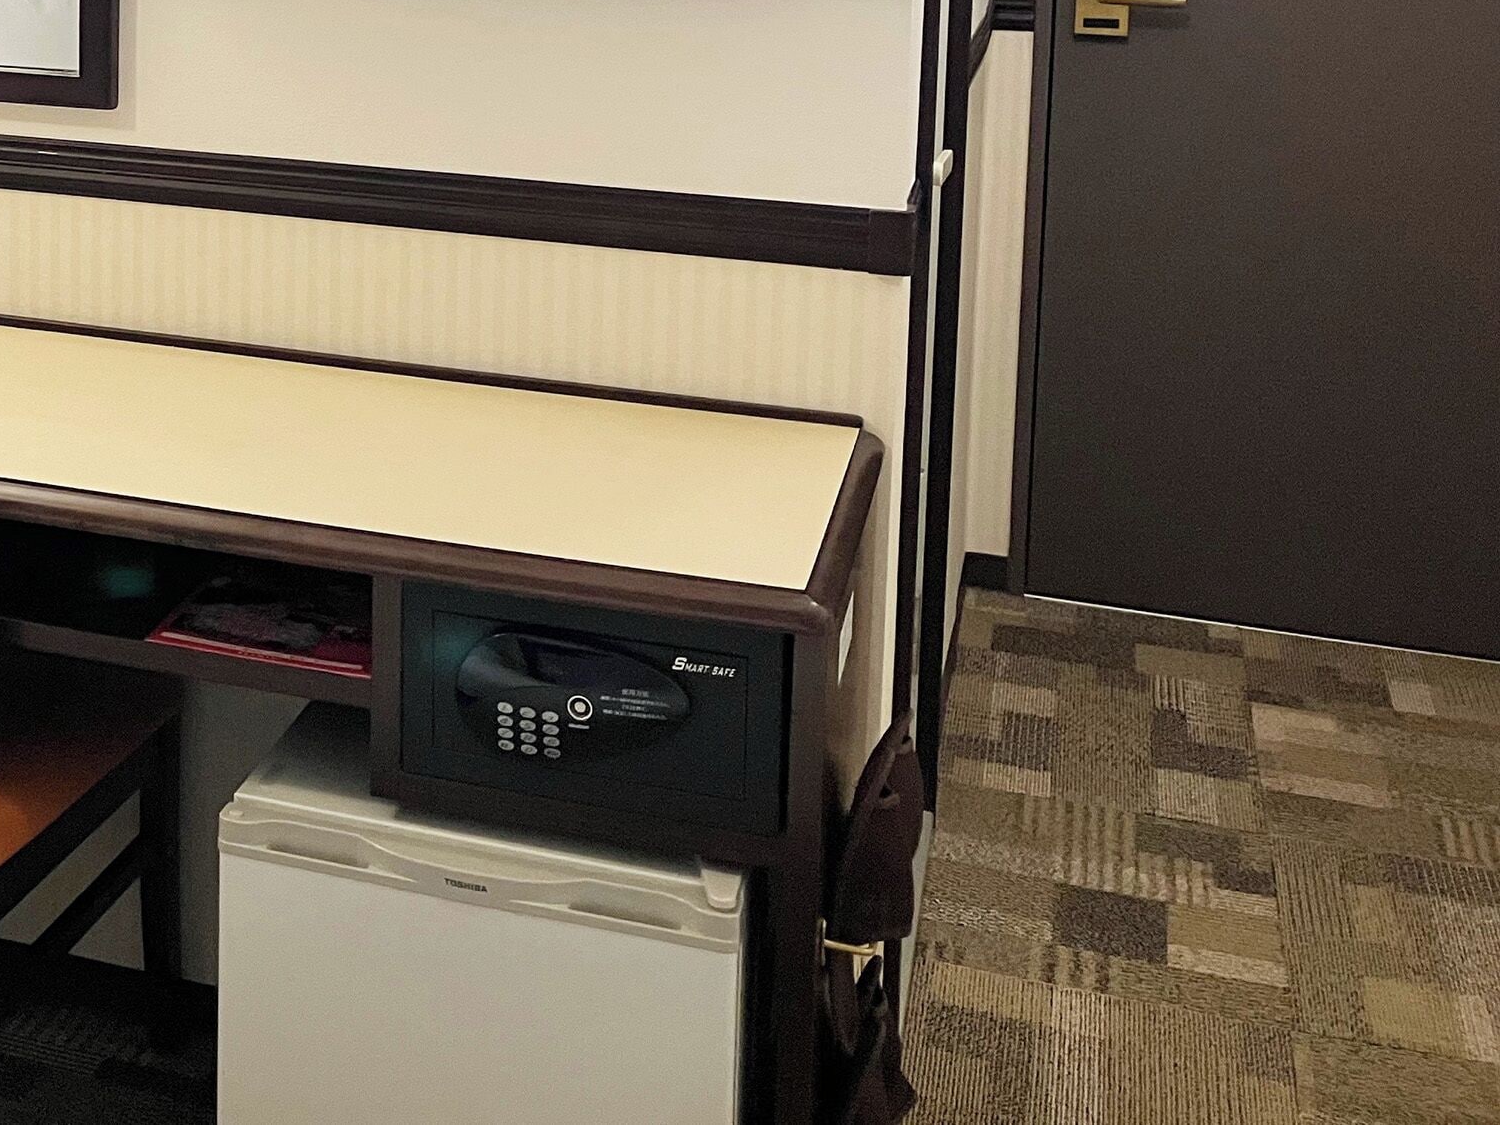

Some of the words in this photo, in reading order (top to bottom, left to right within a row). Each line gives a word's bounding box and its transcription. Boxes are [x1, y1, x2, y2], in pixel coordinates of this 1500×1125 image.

[671, 656, 710, 675] SMART
[712, 664, 737, 678] SAFE
[443, 877, 488, 894] TOSHIBA
